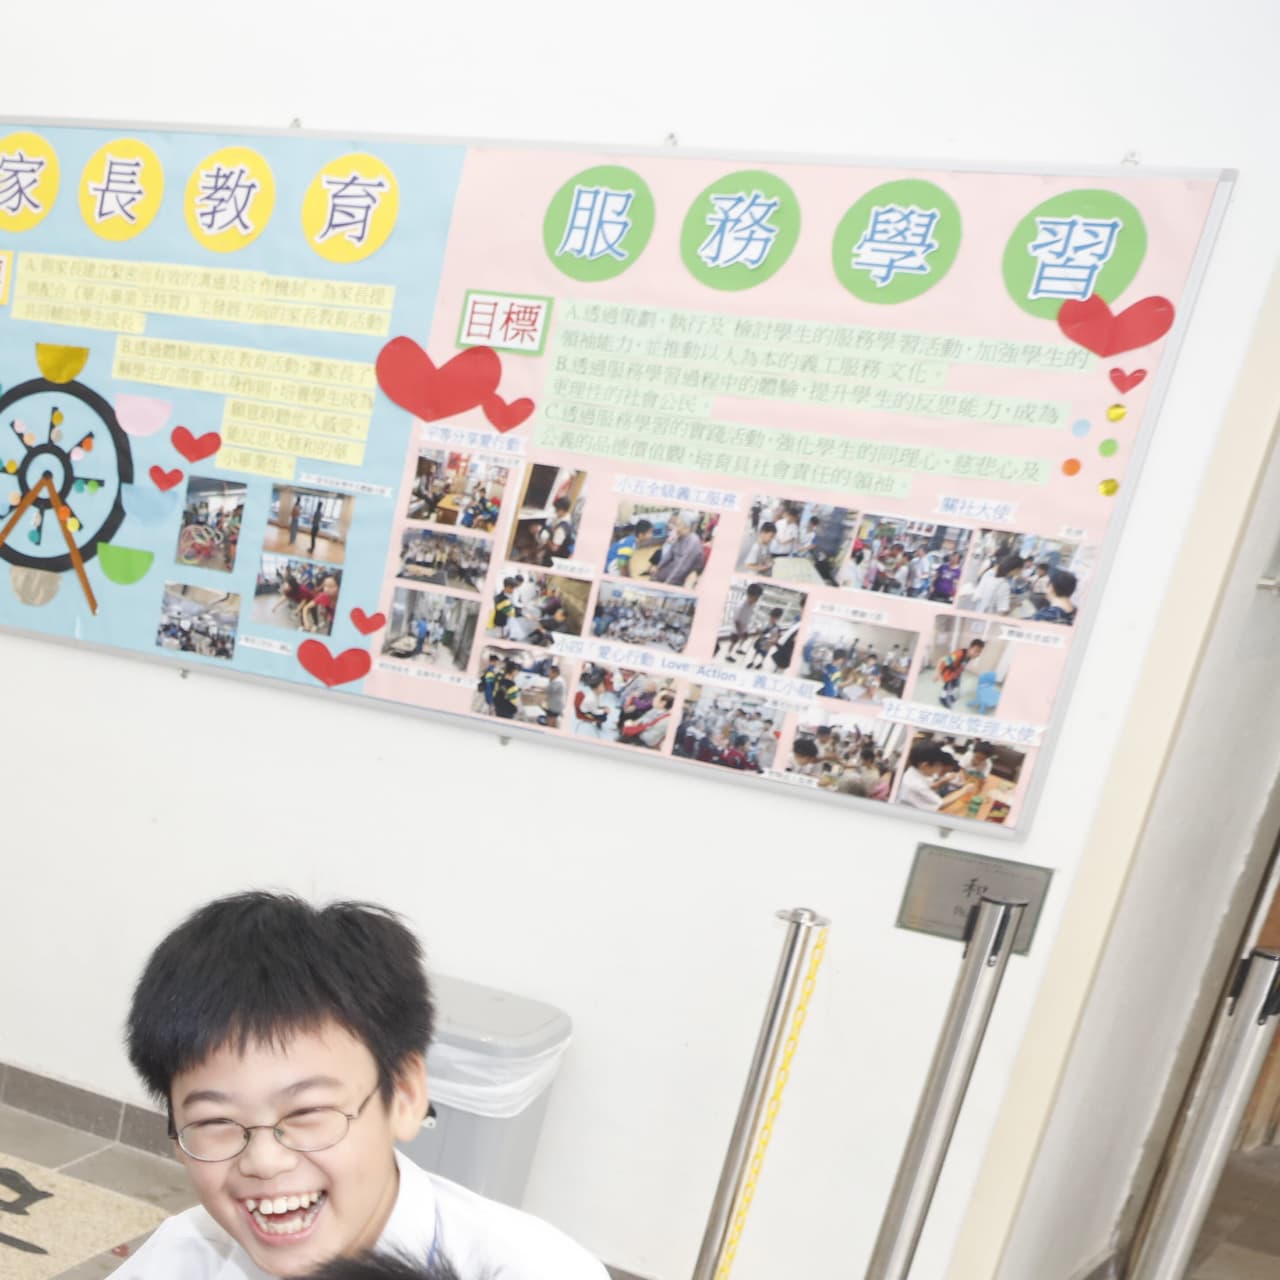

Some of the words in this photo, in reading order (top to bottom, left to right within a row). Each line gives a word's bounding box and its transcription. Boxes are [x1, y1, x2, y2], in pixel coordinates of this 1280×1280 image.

[557, 183, 1122, 302] 服務學習
[464, 300, 541, 346] 目標
[660, 656, 690, 672] Love
